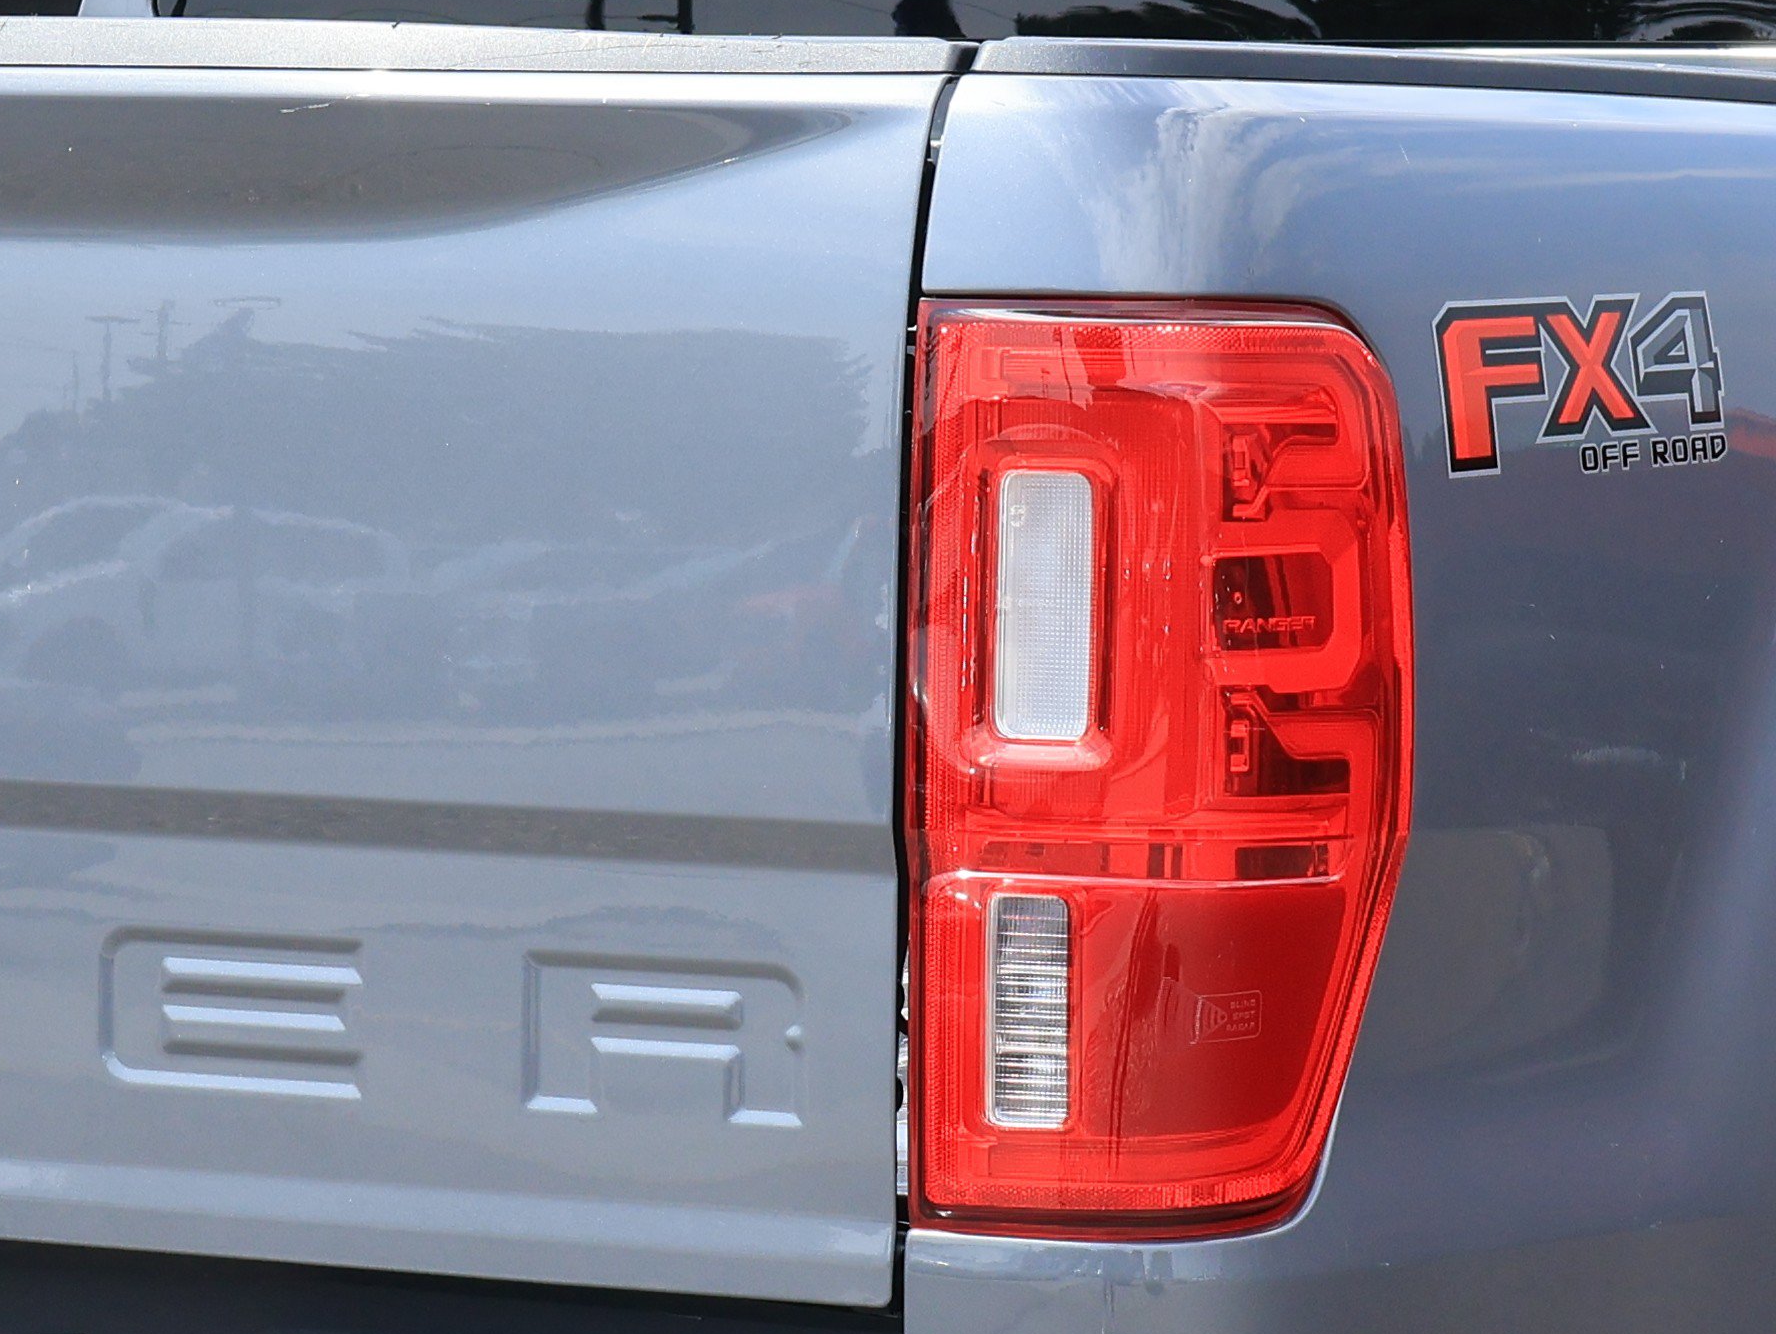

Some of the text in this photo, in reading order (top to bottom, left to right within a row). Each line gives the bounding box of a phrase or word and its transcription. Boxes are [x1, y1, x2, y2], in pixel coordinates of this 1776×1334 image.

[1431, 291, 1724, 479] FX4
[1579, 433, 1728, 474] OFF ROAD
[1222, 615, 1317, 634] RANGER
